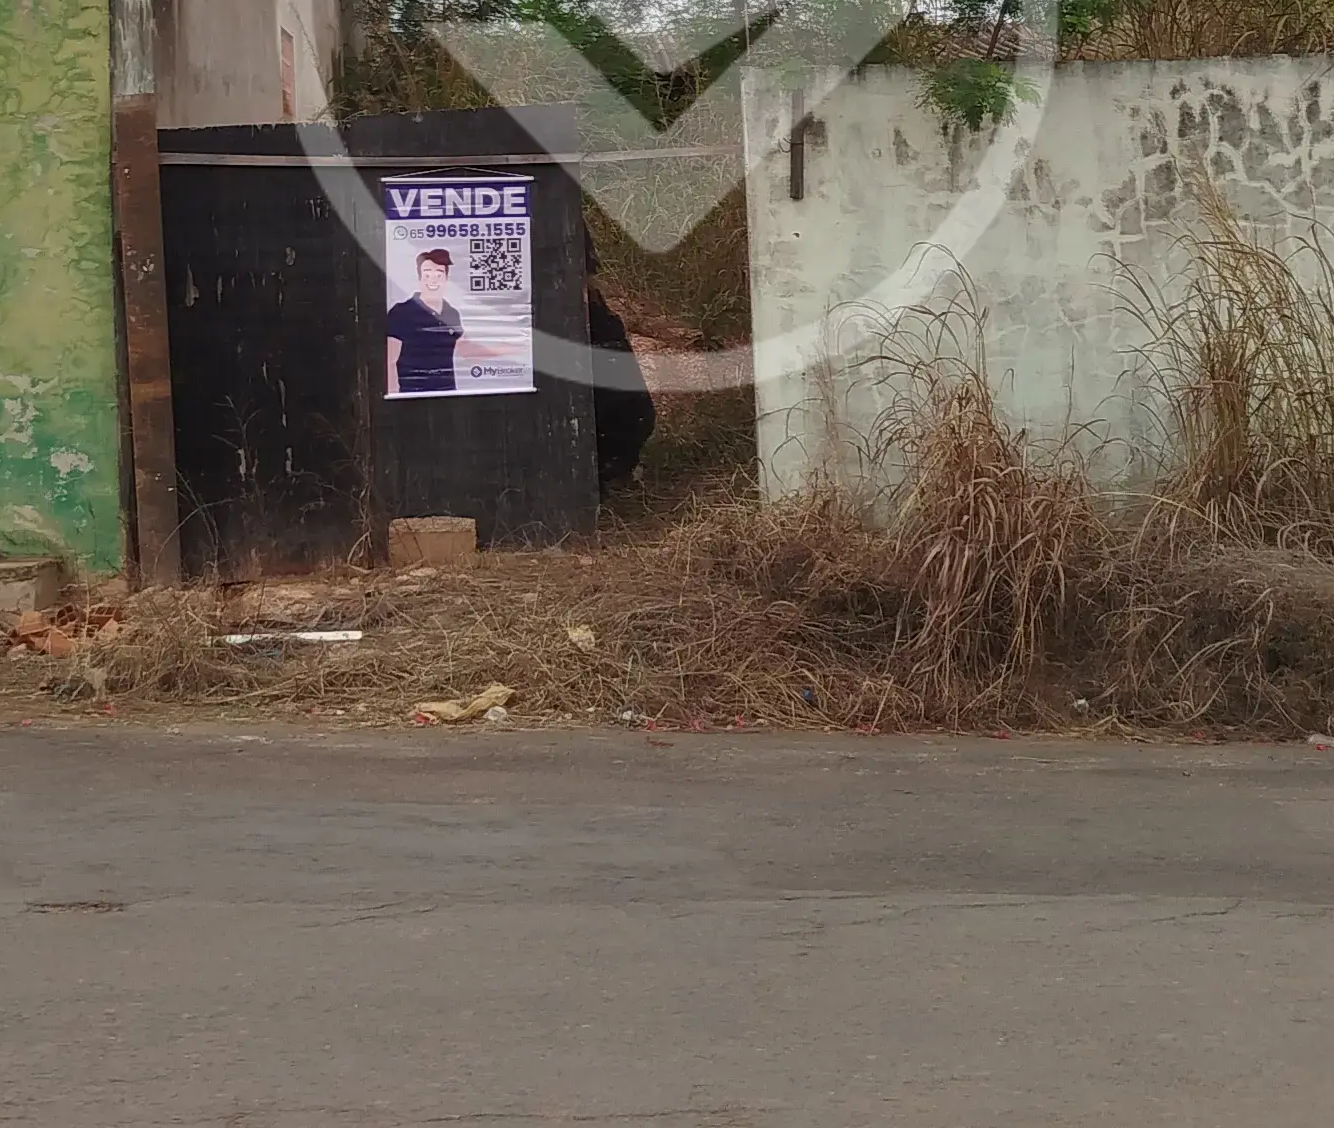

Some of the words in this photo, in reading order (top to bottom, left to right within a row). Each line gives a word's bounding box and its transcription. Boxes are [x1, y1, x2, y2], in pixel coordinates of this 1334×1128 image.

[389, 186, 527, 218] VENDE
[410, 229, 425, 239] 65
[426, 222, 526, 238] 99658.1555
